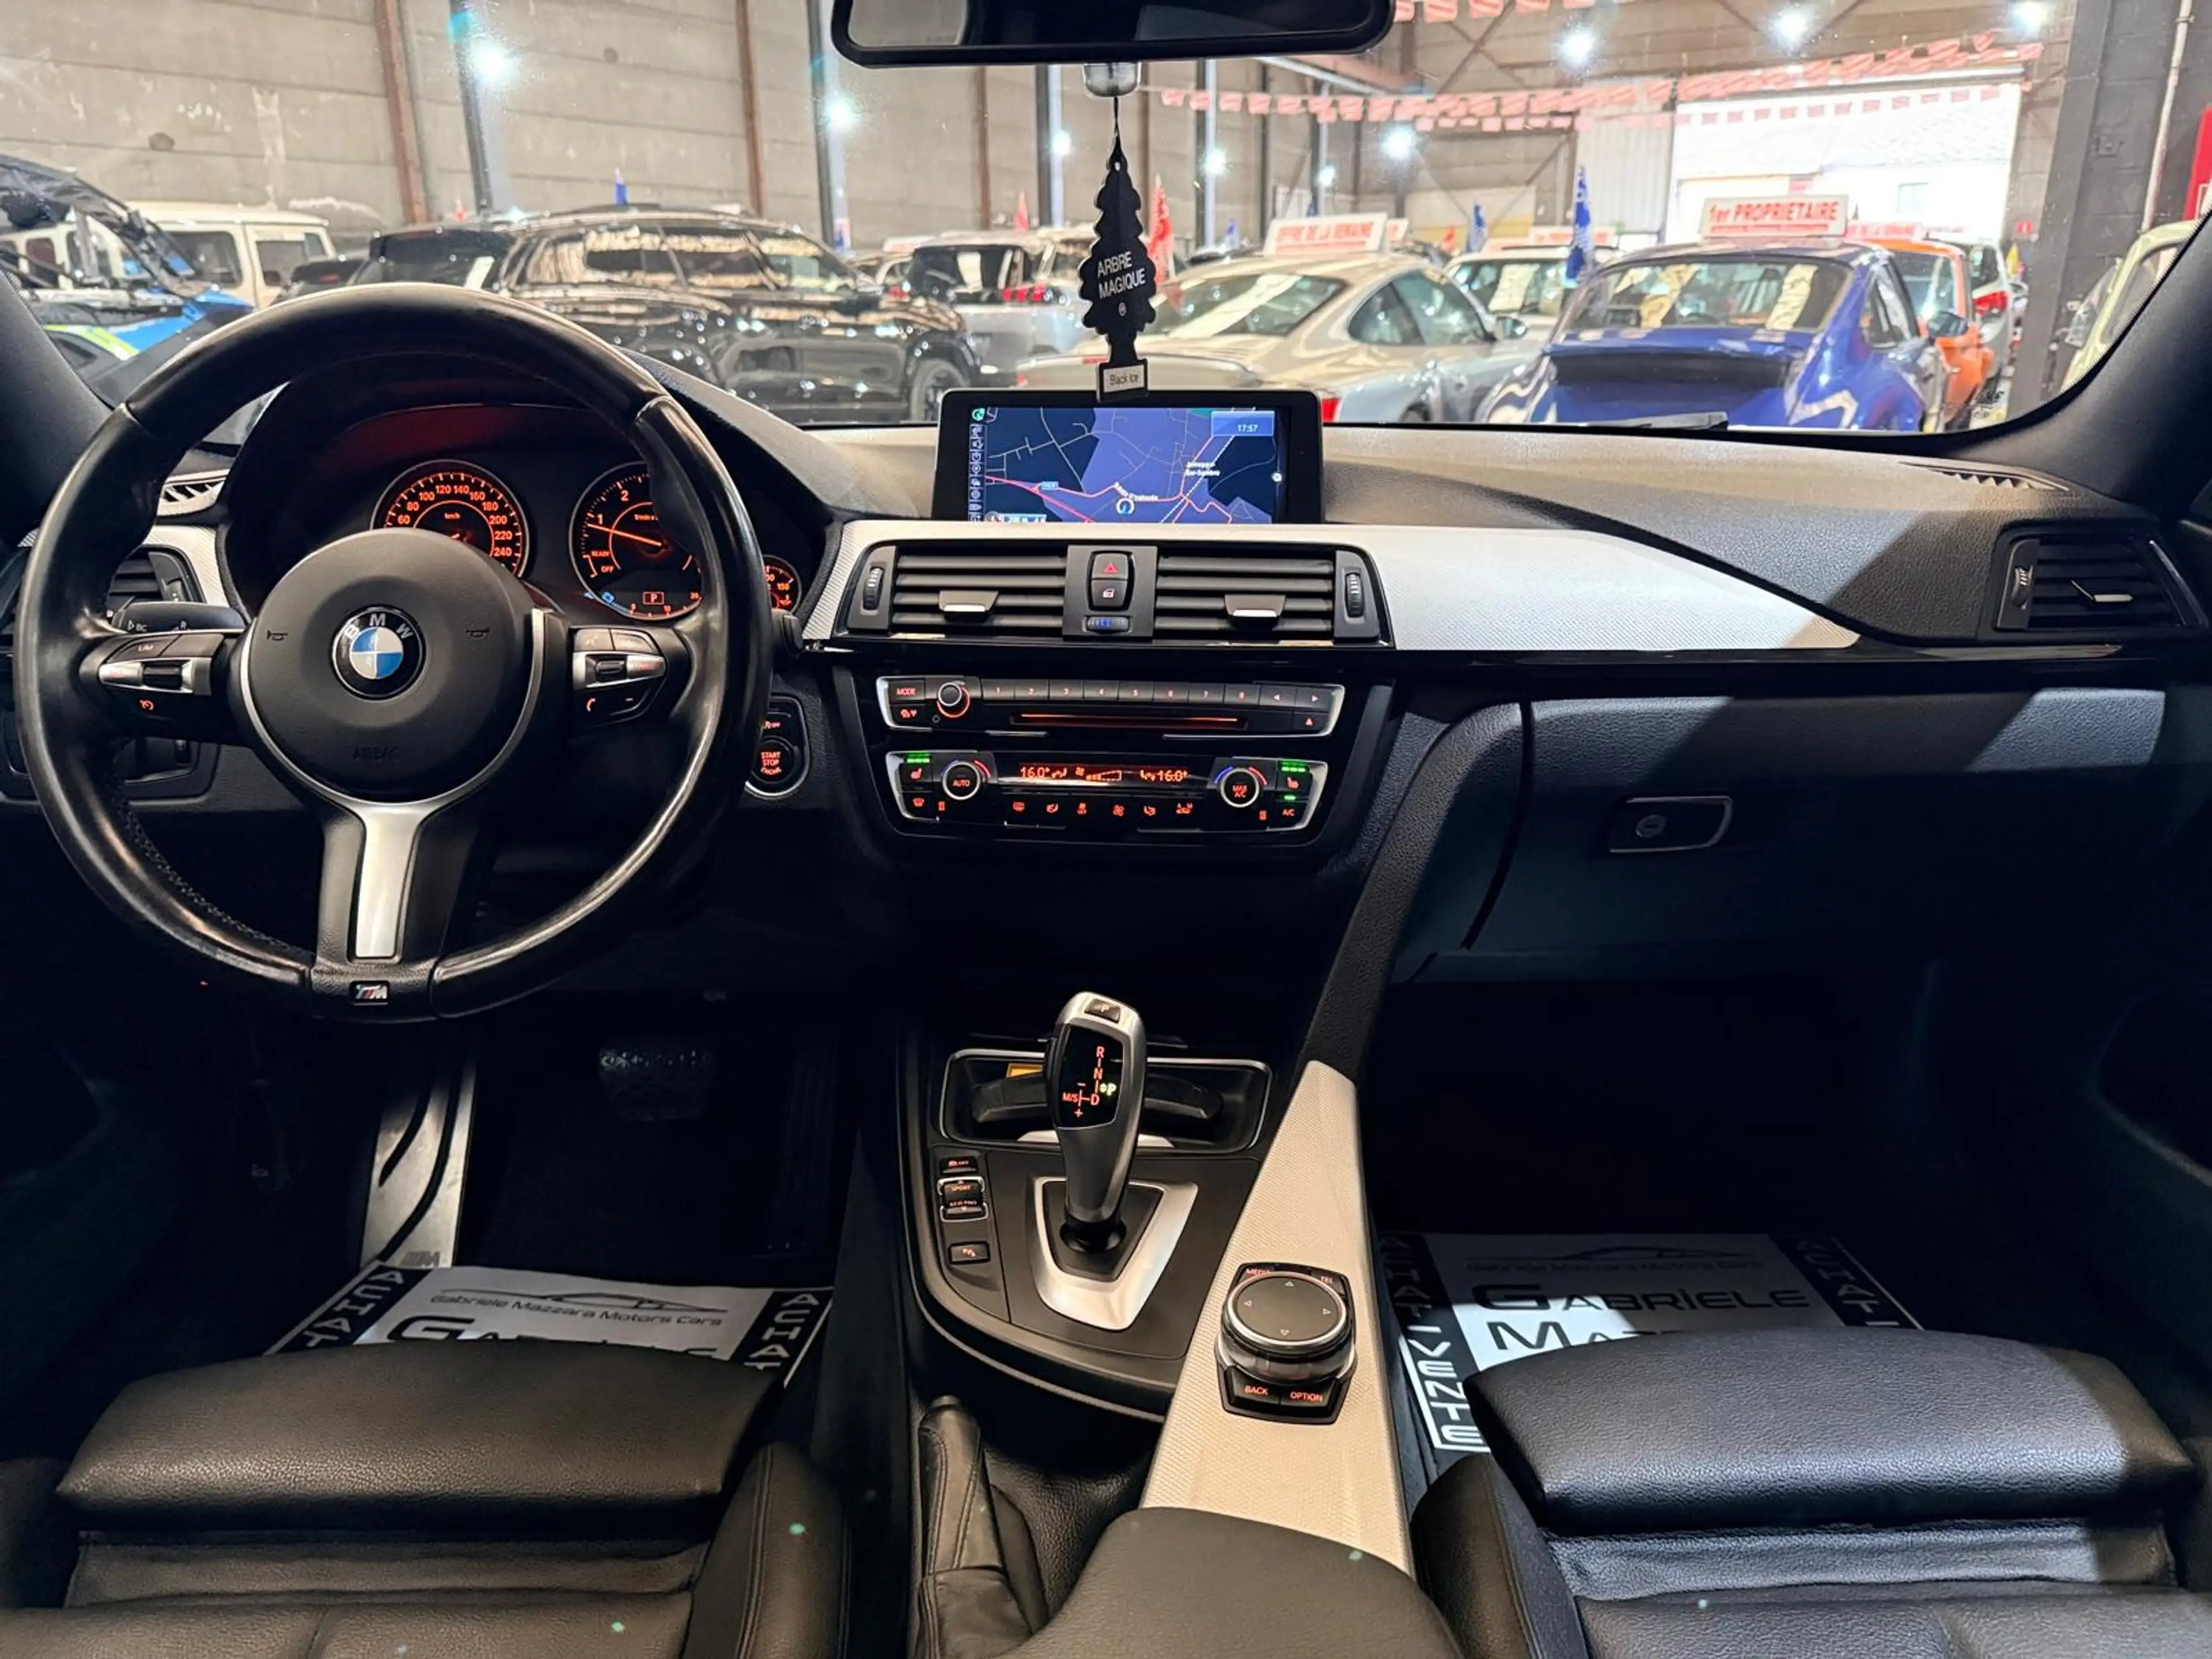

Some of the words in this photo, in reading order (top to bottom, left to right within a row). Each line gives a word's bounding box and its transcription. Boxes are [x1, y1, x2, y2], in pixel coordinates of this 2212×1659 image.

[1098, 251, 1134, 278] ARBRE
[1099, 268, 1146, 299] MAGIQUE
[1109, 374, 1127, 385] Black
[1129, 373, 1139, 382] Ice
[1238, 424, 1258, 432] 17:57
[435, 485, 452, 494] 120
[453, 485, 469, 494] 140
[419, 492, 435, 501] 100
[469, 491, 485, 501] 160
[621, 490, 629, 502] 2
[407, 502, 419, 512] 80
[482, 502, 498, 512] 180
[397, 514, 410, 524] 60
[490, 515, 507, 525] 200
[597, 514, 604, 524] 1
[494, 531, 512, 540] 220
[494, 547, 512, 556] 240
[650, 593, 657, 603] P
[344, 613, 413, 639] BMW
[896, 687, 916, 695] MODE
[1283, 809, 1295, 817] A/C
[1096, 1046, 1105, 1058] R
[1093, 1068, 1103, 1080] N
[1107, 1083, 1116, 1096] P
[1090, 1094, 1100, 1105] D
[1320, 1276, 1334, 1284] TEL
[303, 1270, 404, 1347] ACHAT
[599, 1310, 672, 1324] Motors
[676, 1315, 723, 1326] Cars
[1244, 1385, 1268, 1395] BACK
[1290, 1391, 1323, 1402] OPTION
